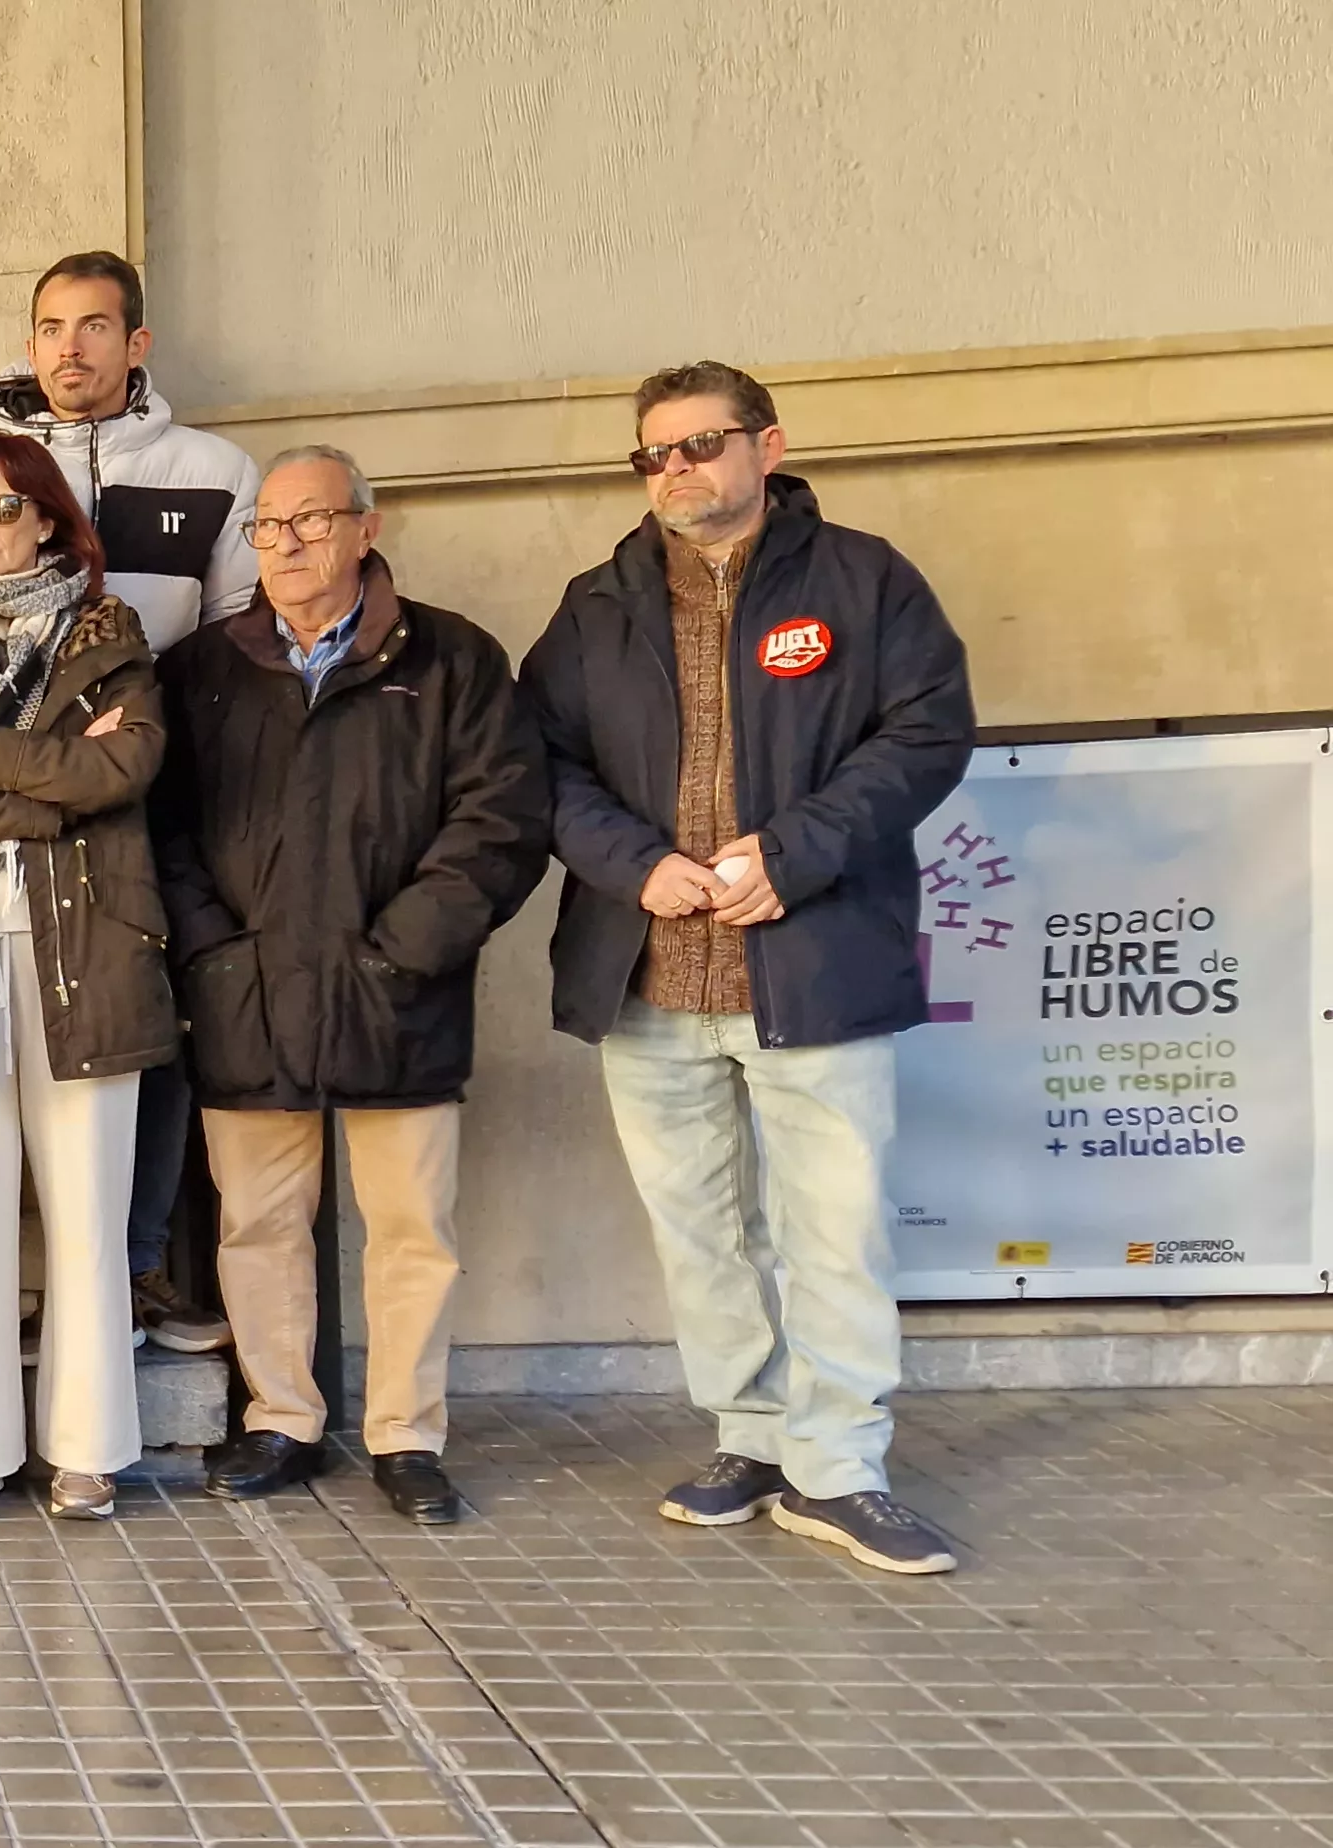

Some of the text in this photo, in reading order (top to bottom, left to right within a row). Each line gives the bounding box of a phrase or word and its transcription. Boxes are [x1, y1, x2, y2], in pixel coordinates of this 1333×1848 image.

[767, 624, 820, 653] UGT
[1044, 897, 1215, 944] espacio
[1042, 940, 1239, 979] LIBRE de
[1041, 978, 1240, 1019] HUMOS
[1042, 1032, 1236, 1070] un espacio
[1045, 1065, 1236, 1101] que respira
[1047, 1097, 1238, 1134] un espacio
[1081, 1129, 1246, 1158] saludable
[1155, 1253, 1174, 1264] DE
[1156, 1239, 1234, 1252] GOBIERNO
